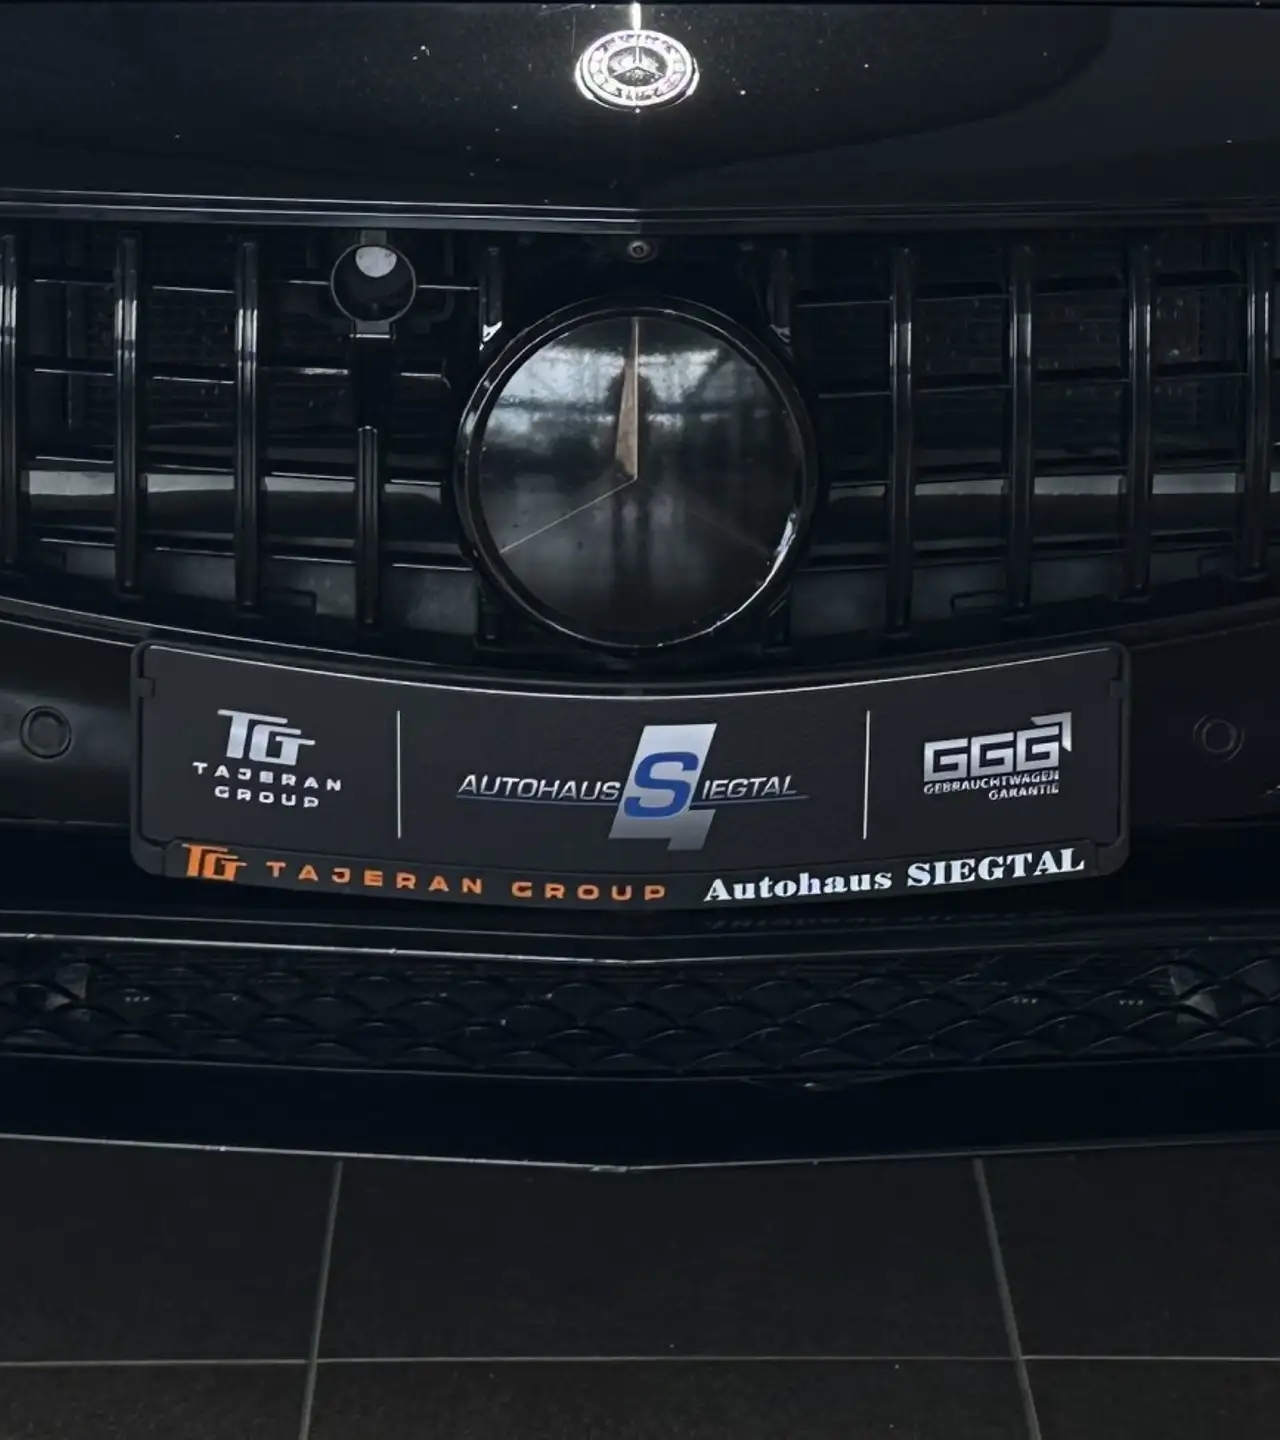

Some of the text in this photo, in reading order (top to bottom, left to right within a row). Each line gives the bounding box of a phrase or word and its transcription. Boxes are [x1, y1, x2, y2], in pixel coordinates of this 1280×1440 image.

[923, 724, 1061, 783] GGG
[192, 761, 342, 792] TAJERAN
[457, 774, 622, 801] AUTOHAUS
[923, 770, 1061, 795] GEBRAUCHTWAGEN
[214, 785, 320, 808] GROUP
[988, 782, 1061, 801] GARANTIE
[266, 861, 483, 896] TAJERAN
[511, 881, 666, 902] GROUP
[703, 847, 1086, 903] Autohaus SIEGTAL
